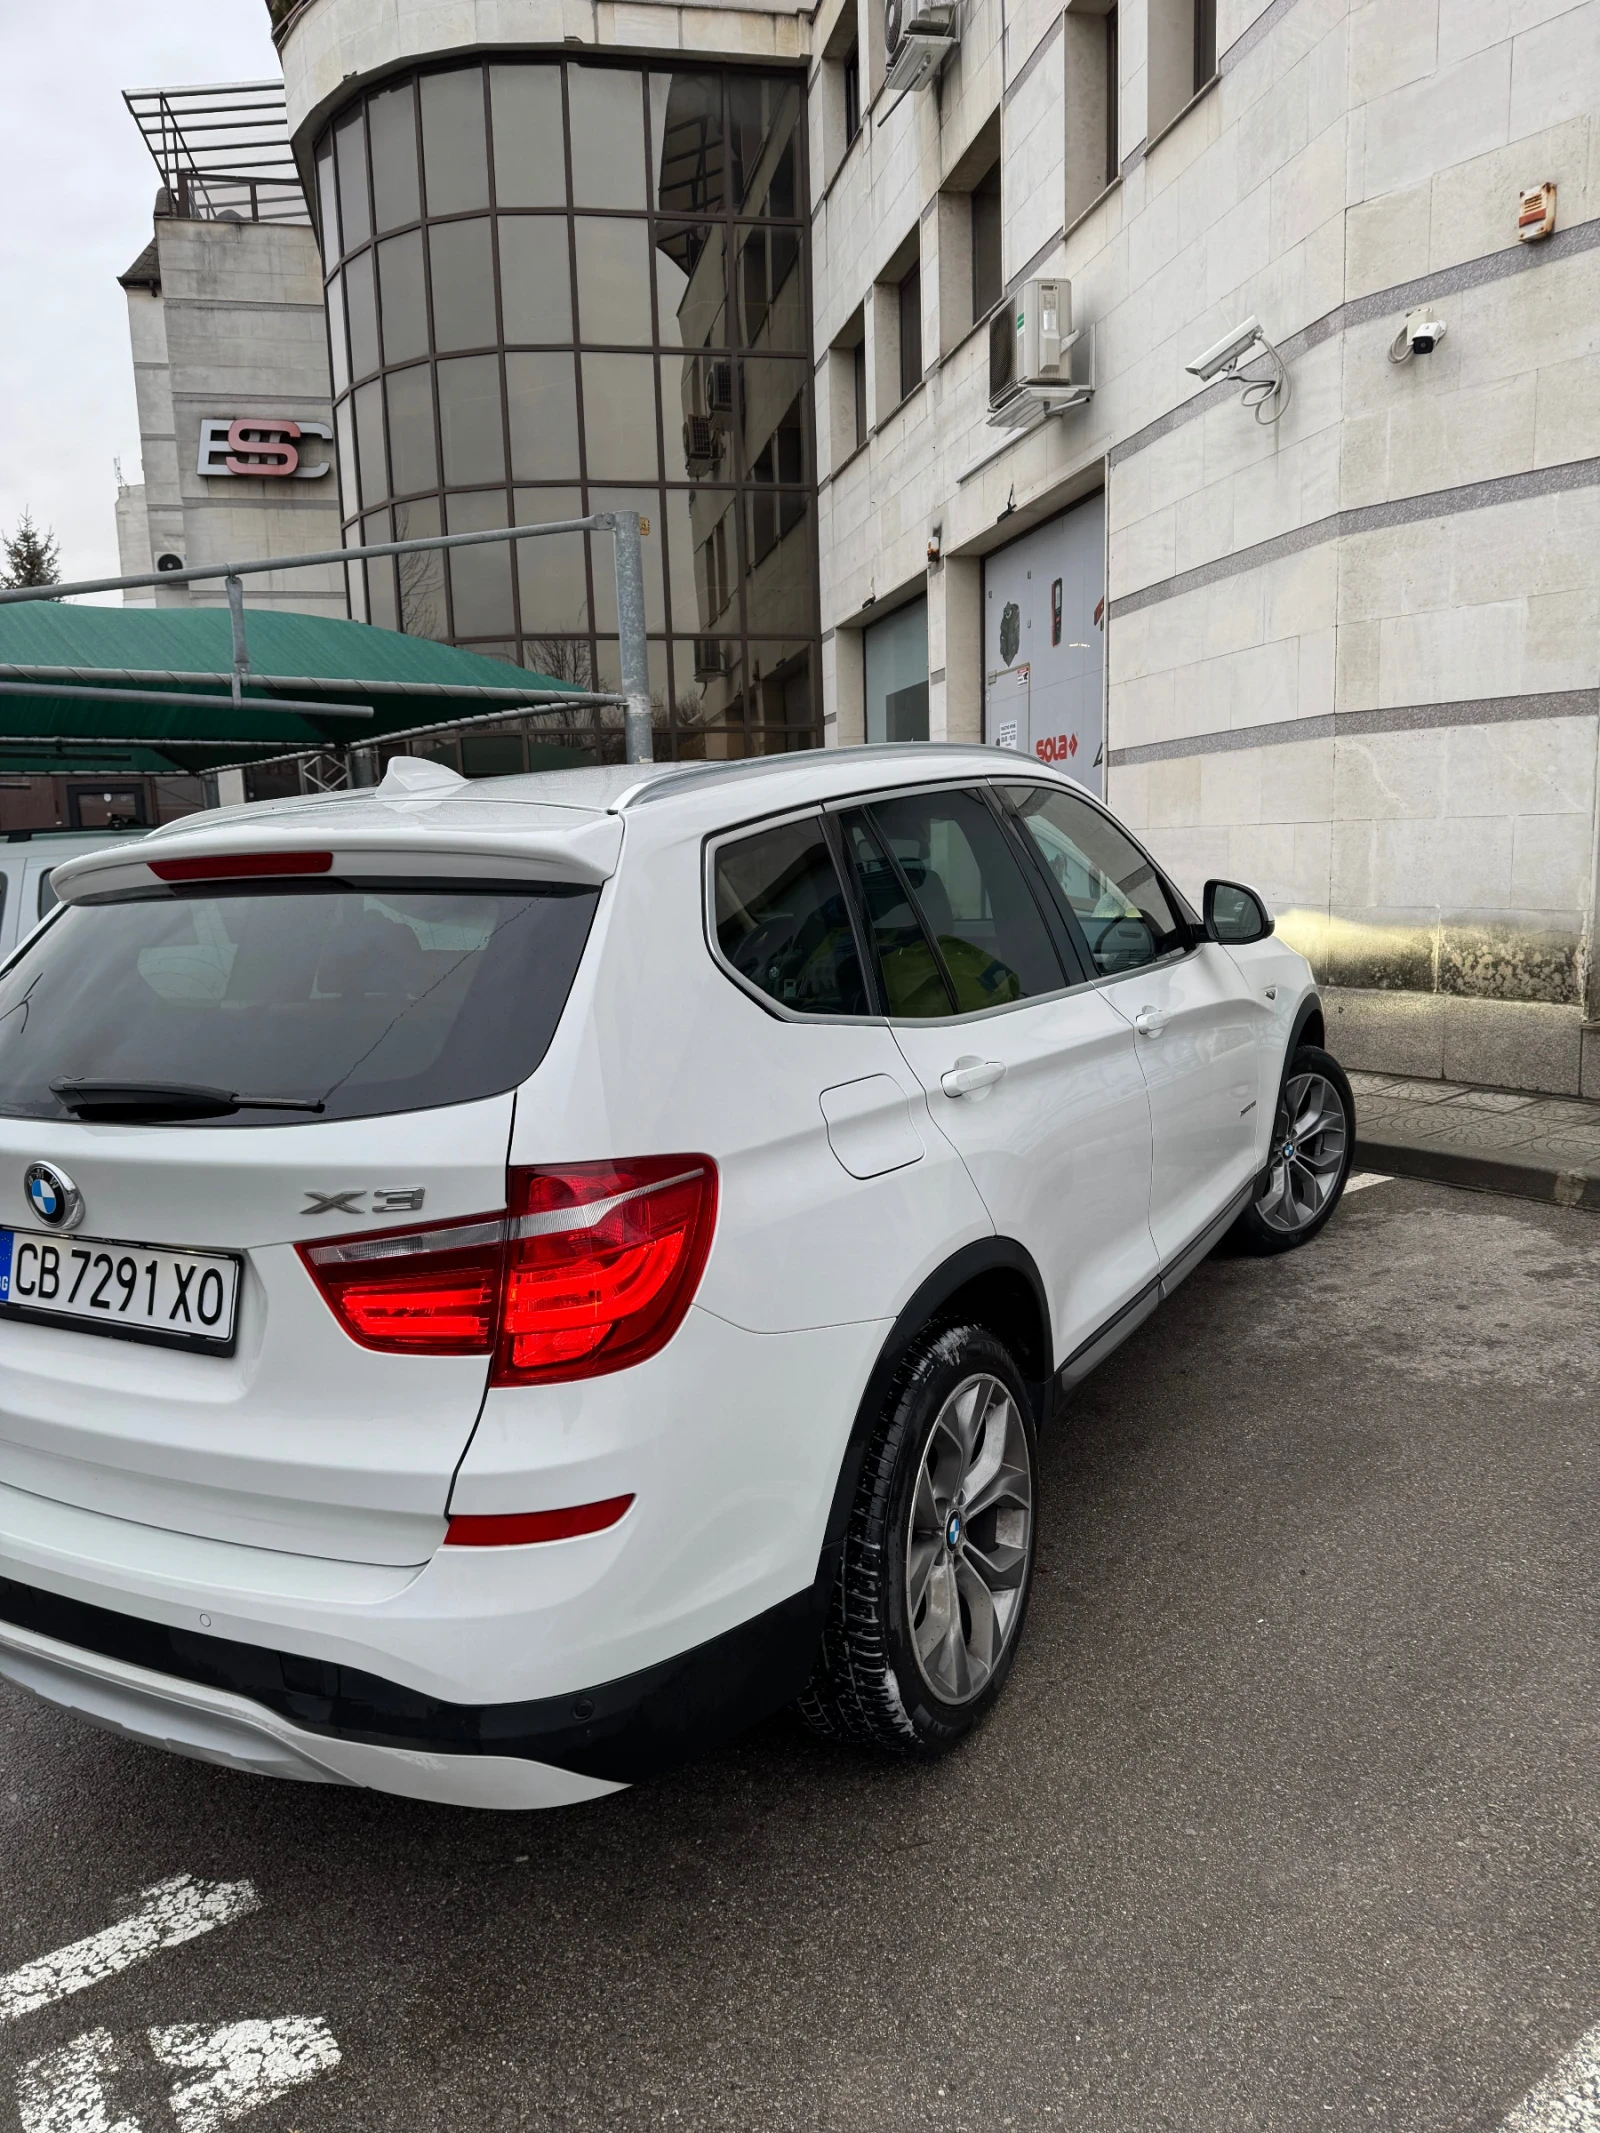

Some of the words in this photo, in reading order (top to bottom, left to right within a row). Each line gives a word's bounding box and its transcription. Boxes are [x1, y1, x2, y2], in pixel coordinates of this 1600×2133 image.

[197, 418, 333, 479] ESC
[299, 1186, 426, 1214] X3
[0, 1275, 9, 1291] G
[16, 1242, 60, 1299] CB
[67, 1248, 158, 1317] 7291
[168, 1262, 224, 1326] XO
